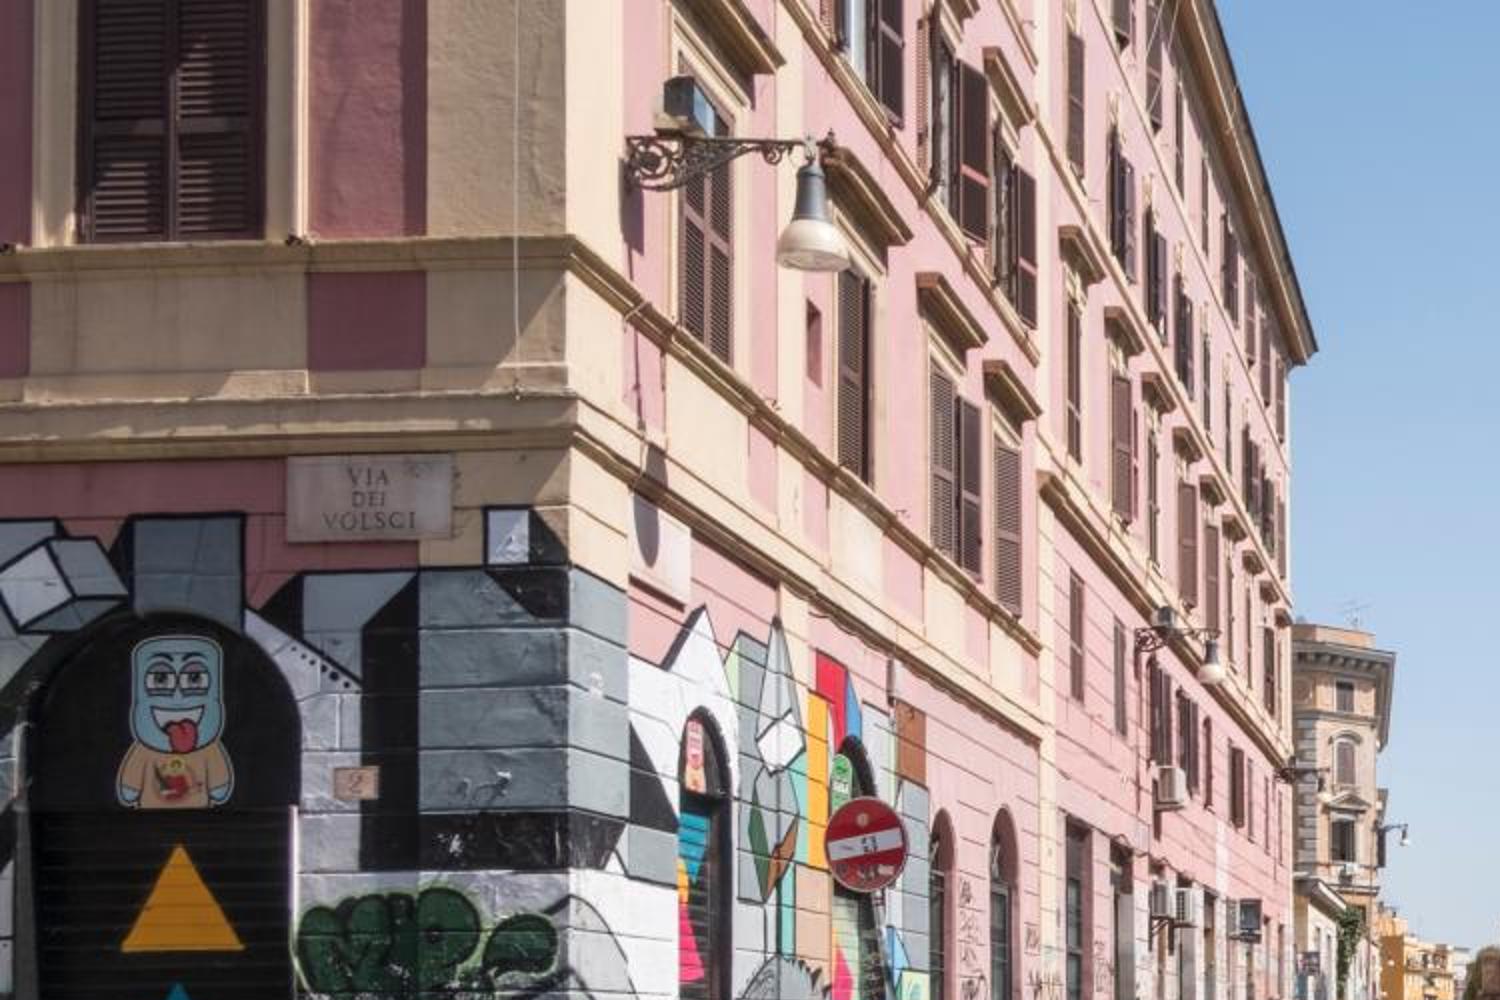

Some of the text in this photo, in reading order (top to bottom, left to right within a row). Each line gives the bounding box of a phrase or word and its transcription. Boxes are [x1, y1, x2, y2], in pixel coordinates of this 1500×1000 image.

[348, 466, 390, 486] VIA
[351, 490, 386, 507] DEI
[321, 511, 416, 531] VOLSCI
[348, 771, 364, 795] 2
